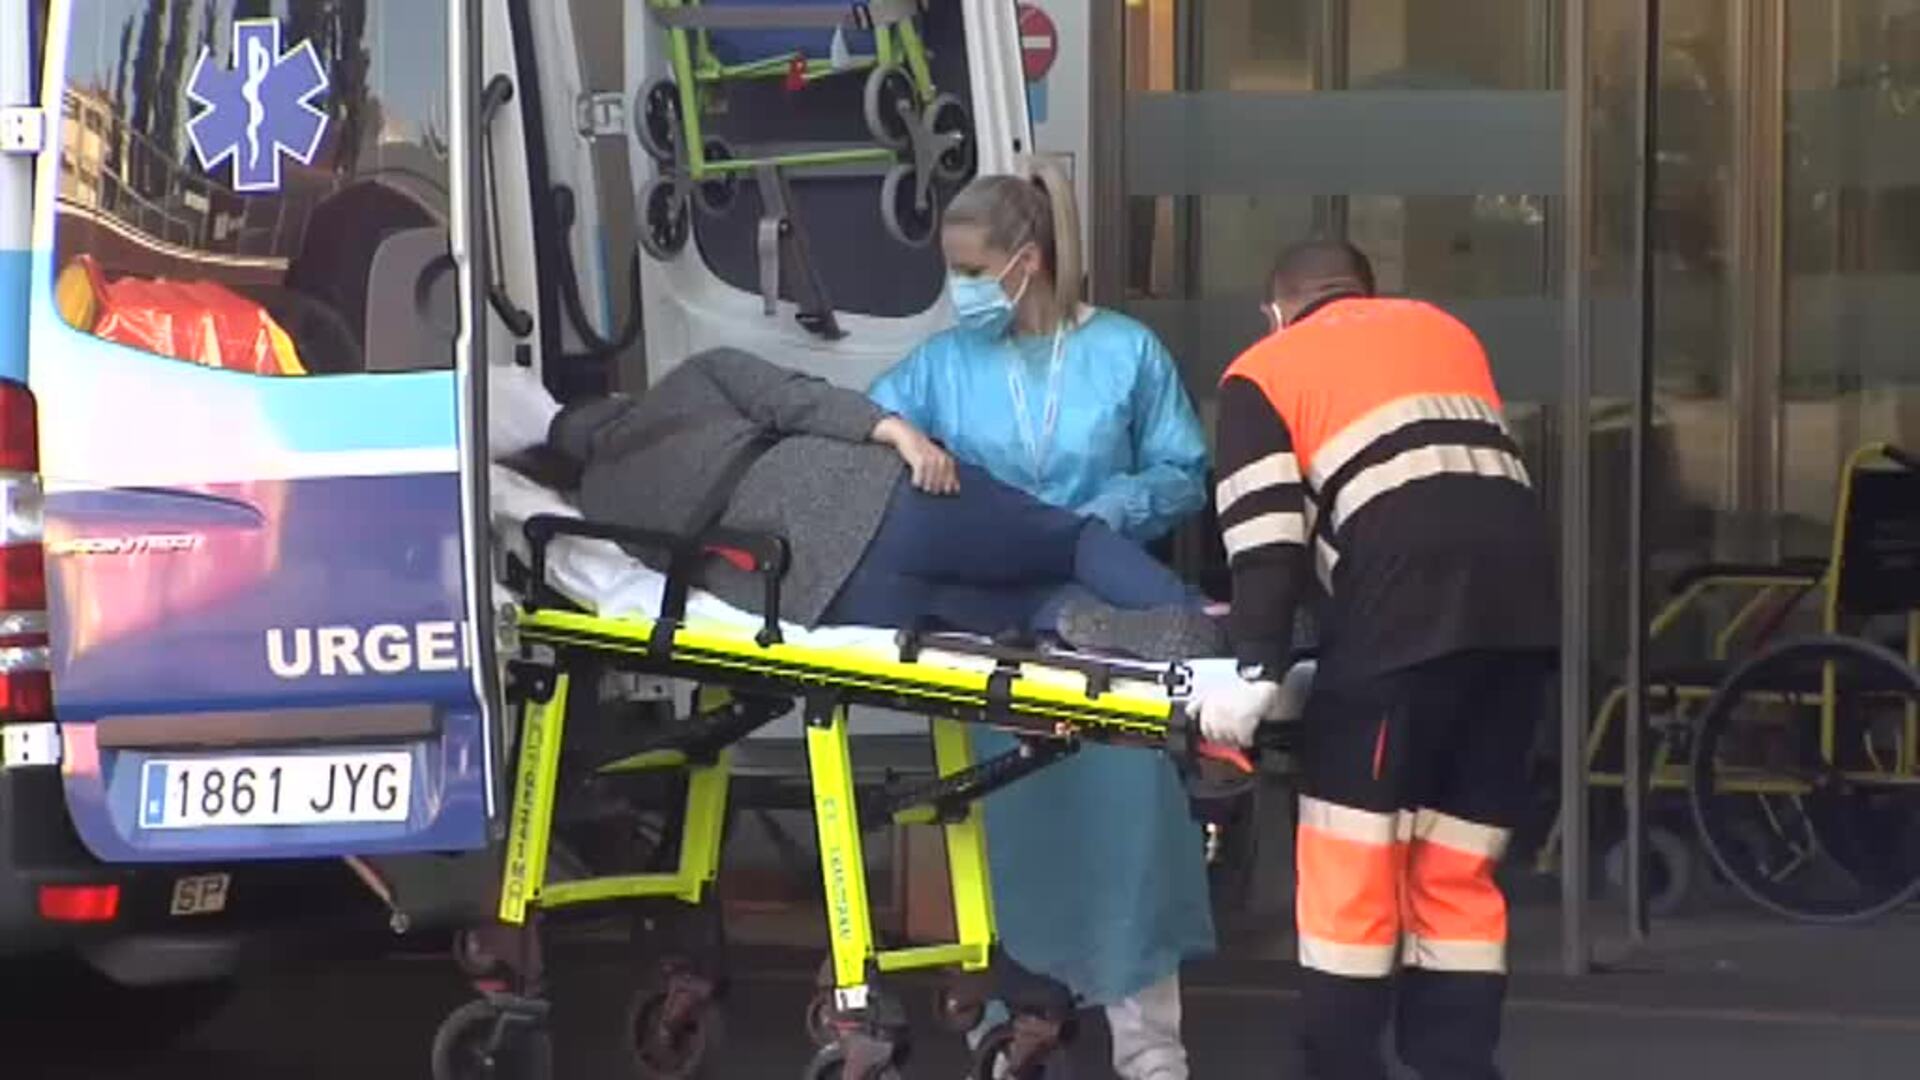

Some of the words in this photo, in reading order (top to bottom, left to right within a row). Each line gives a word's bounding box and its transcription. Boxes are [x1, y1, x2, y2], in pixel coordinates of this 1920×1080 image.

[178, 766, 282, 818] 1861
[309, 762, 398, 813] JYG
[176, 879, 224, 911] SP
